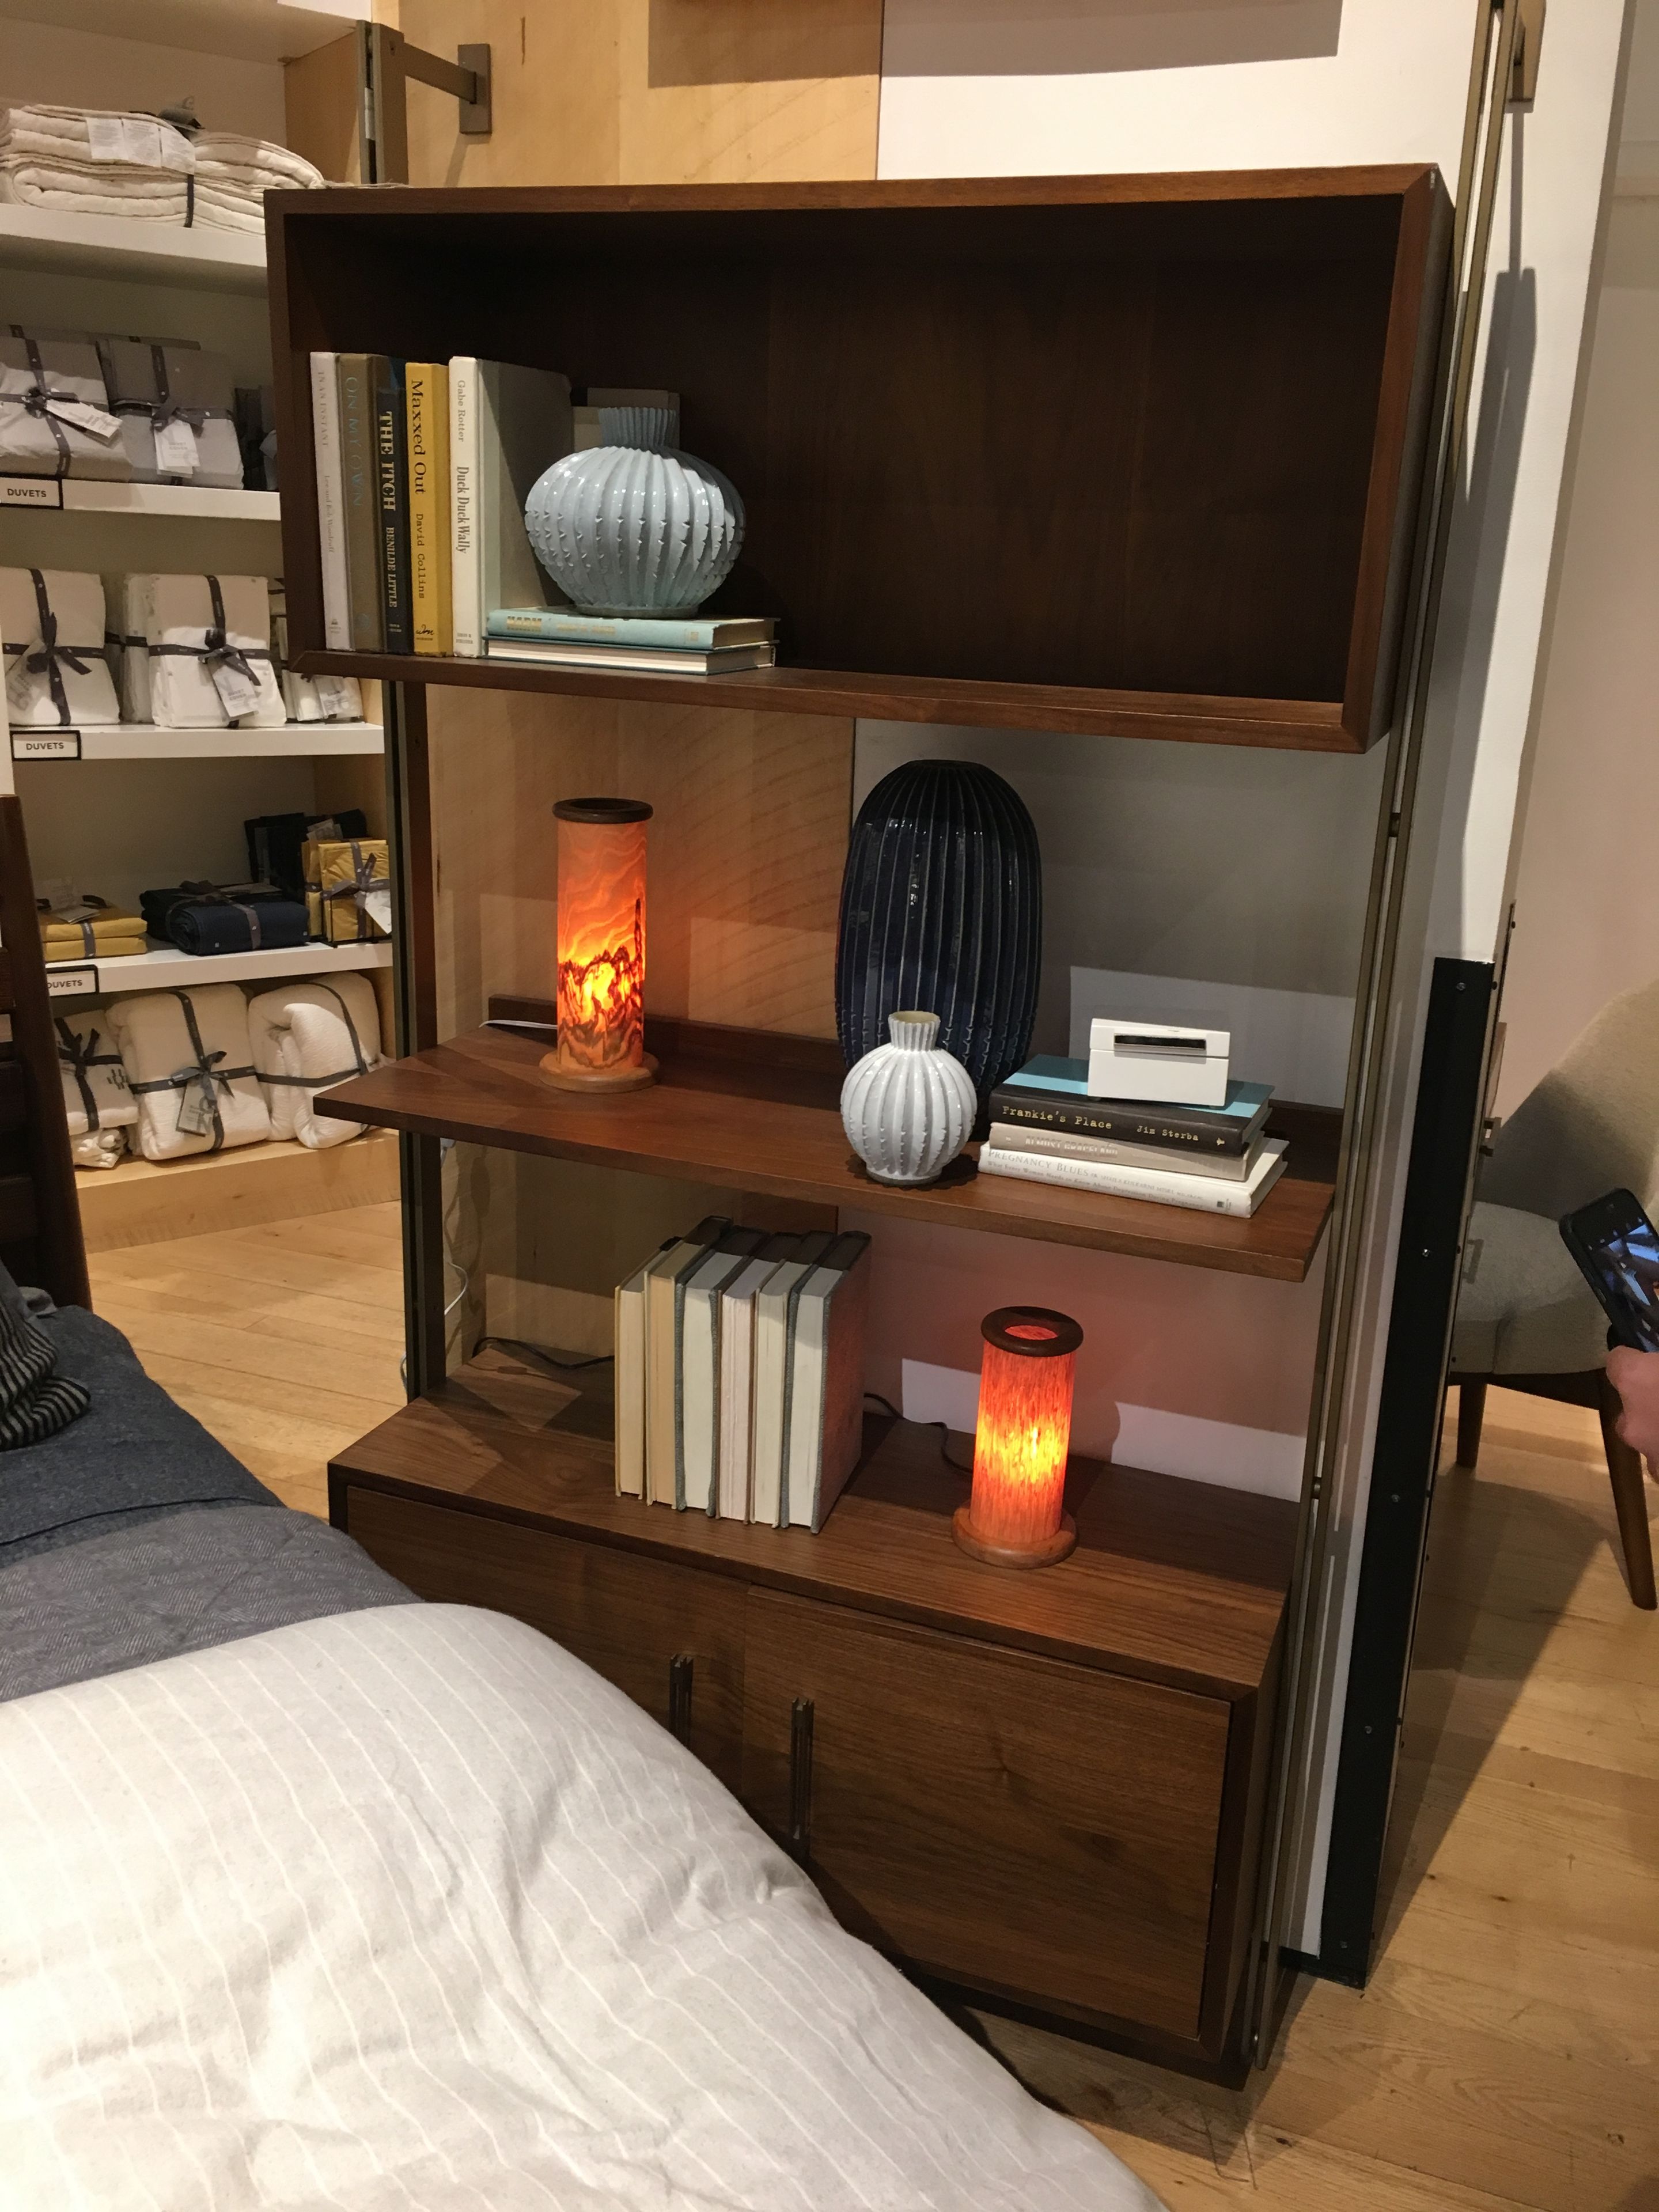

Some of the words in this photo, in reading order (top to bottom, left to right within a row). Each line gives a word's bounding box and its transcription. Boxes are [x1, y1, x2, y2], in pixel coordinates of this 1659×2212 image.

[319, 388, 327, 399] AN
[346, 377, 359, 410] ON
[457, 380, 466, 407] Gabe
[320, 403, 329, 446] INSTANT
[349, 418, 362, 448] MY
[379, 411, 394, 454] THE
[411, 379, 426, 456] Maxxed
[457, 410, 466, 442] Rotter
[7, 488, 47, 498] DUVETS
[349, 454, 363, 506] OWN
[381, 461, 396, 512] ITCH
[414, 462, 427, 494] Out
[456, 466, 469, 494] Duck
[457, 497, 470, 524] Duck
[416, 513, 425, 546] David
[456, 525, 470, 554] Wally
[386, 527, 396, 571] BENILDE
[388, 573, 397, 608] LITTLE
[417, 553, 425, 599] Collins
[26, 742, 65, 751] DUVETS
[1002, 1105, 1066, 1123] Frankie's
[1074, 1116, 1112, 1129] Place
[1137, 1125, 1156, 1135] Jim
[1162, 1129, 1199, 1141] Sterba
[988, 1150, 1052, 1169] PREGNANCY
[1056, 1162, 1089, 1177] BLUES
